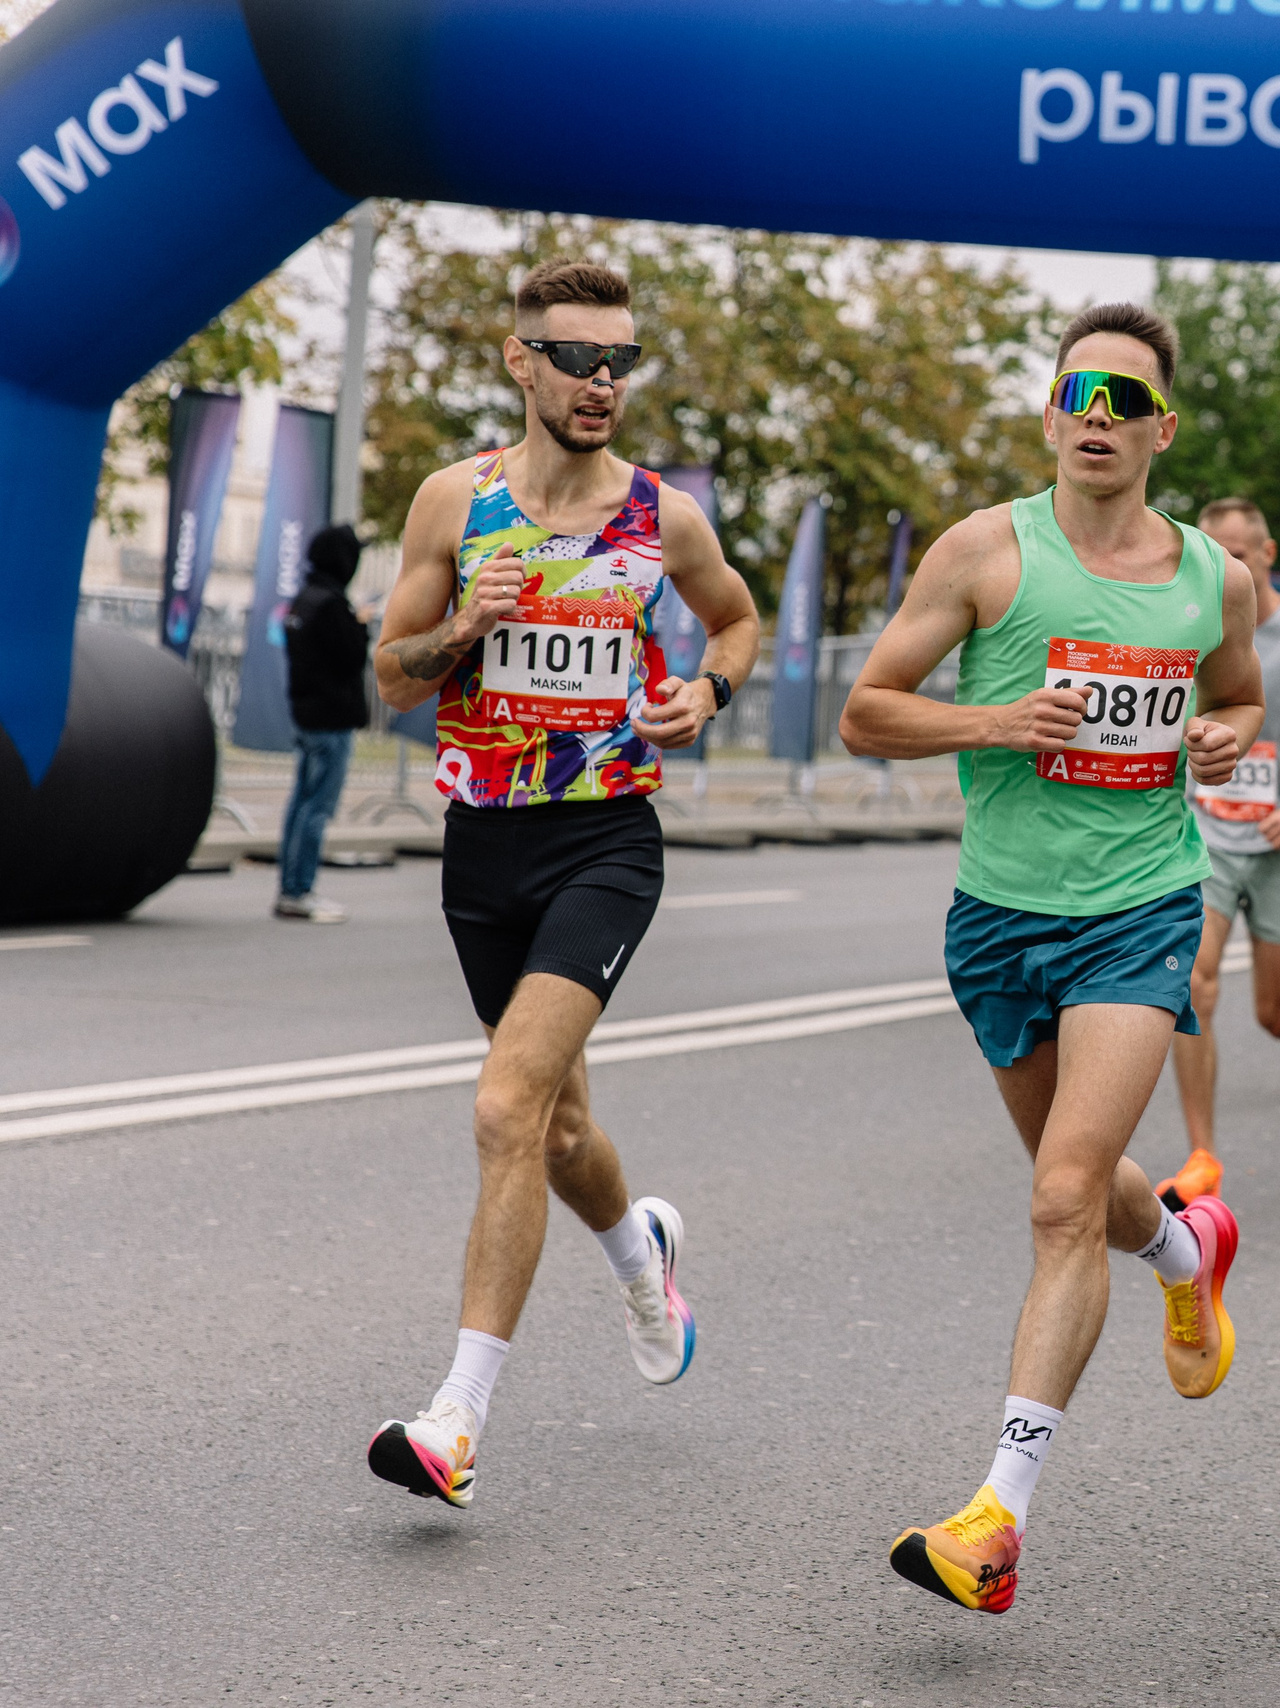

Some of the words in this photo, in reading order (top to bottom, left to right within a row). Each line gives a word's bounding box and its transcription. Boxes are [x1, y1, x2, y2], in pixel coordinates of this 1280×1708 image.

[577, 615, 595, 627] 10
[599, 616, 624, 628] KM
[493, 628, 621, 674] 11011
[1107, 663, 1123, 671] 2025
[1145, 664, 1162, 677] 10
[1165, 665, 1187, 678] KM
[530, 677, 582, 691] MAKSIM
[493, 698, 513, 721] A
[1054, 678, 1186, 728] 0810
[1100, 733, 1138, 747] ИВАН
[1047, 754, 1069, 780] A
